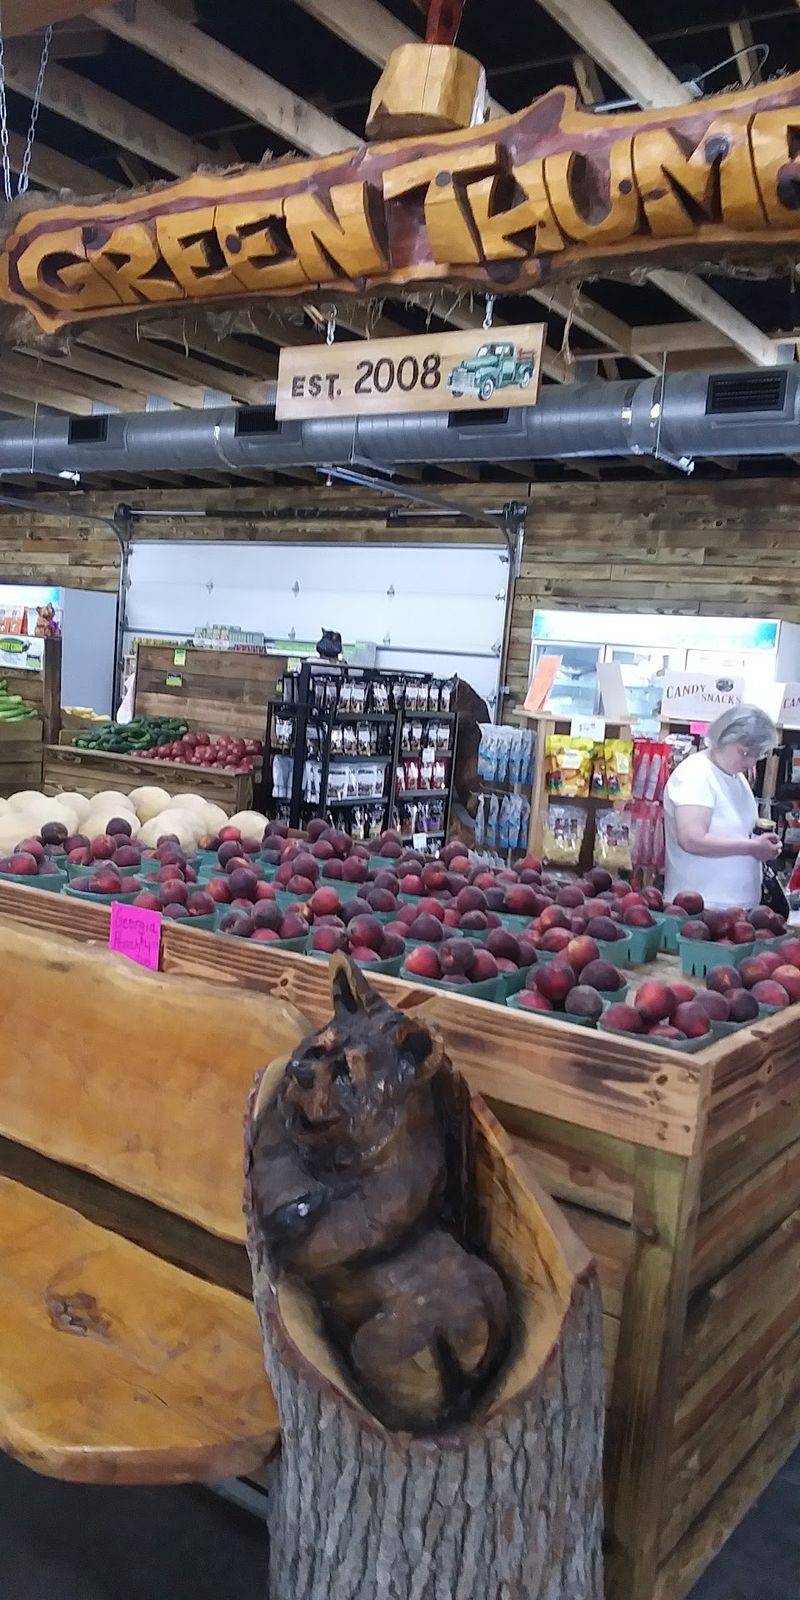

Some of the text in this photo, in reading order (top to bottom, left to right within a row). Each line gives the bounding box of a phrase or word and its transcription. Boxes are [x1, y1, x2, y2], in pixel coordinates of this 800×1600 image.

[16, 182, 389, 308] GREEN
[291, 352, 441, 400] EST. 2008
[666, 684, 707, 699] CANDY
[702, 693, 742, 705] SNACKS
